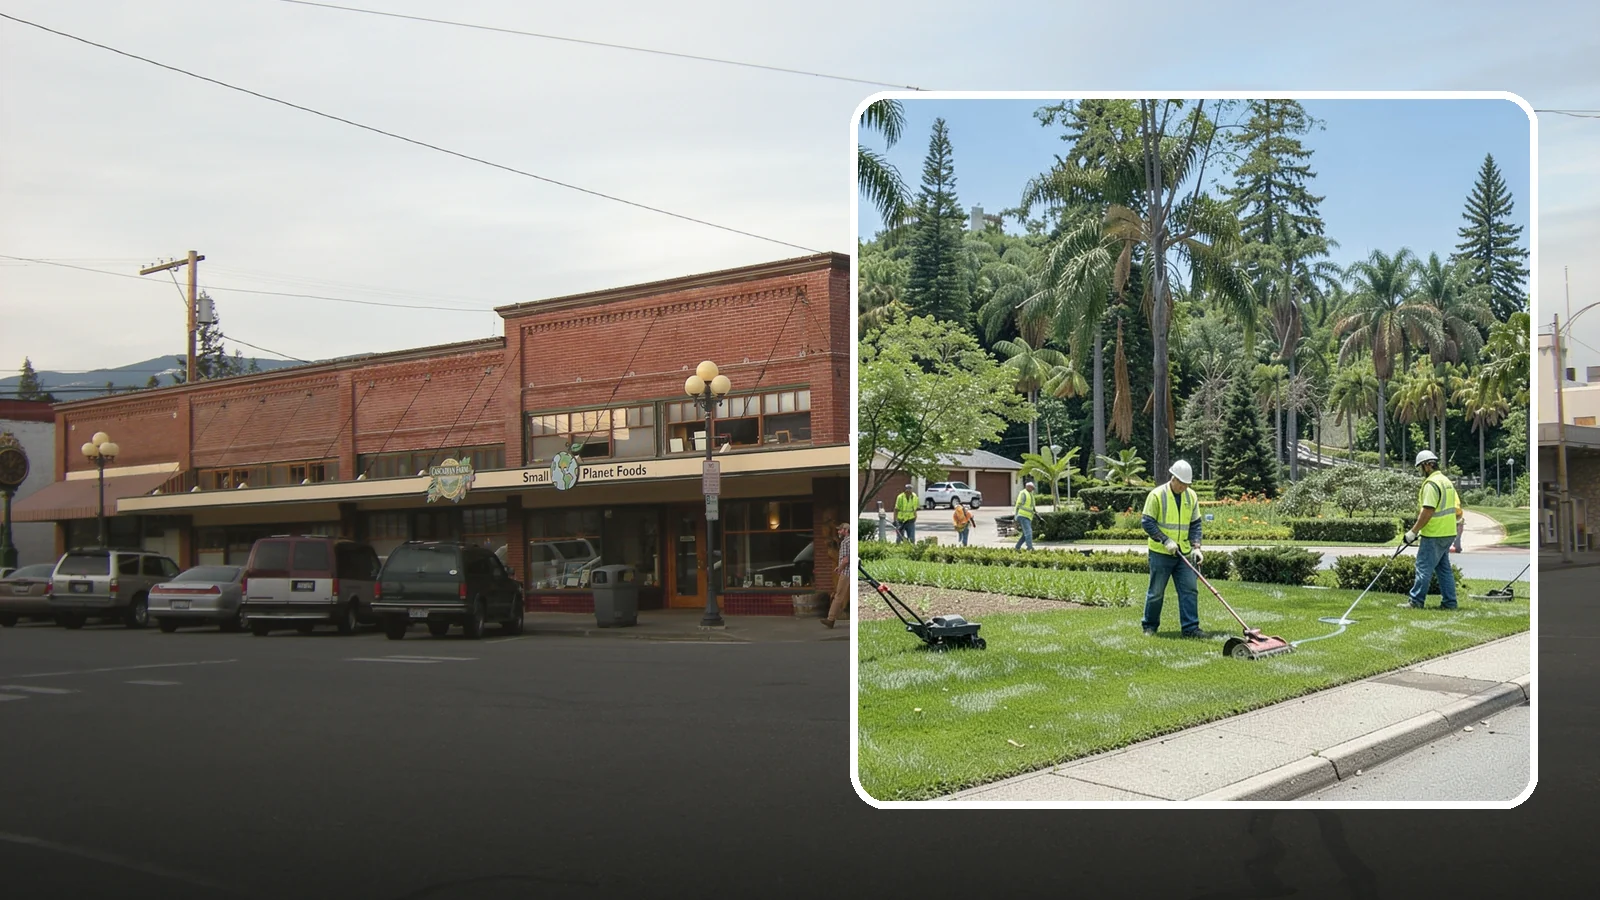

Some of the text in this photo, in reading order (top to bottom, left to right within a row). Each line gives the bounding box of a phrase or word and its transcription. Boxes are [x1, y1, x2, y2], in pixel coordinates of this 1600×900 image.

[523, 464, 647, 483] Small Planet Foods
